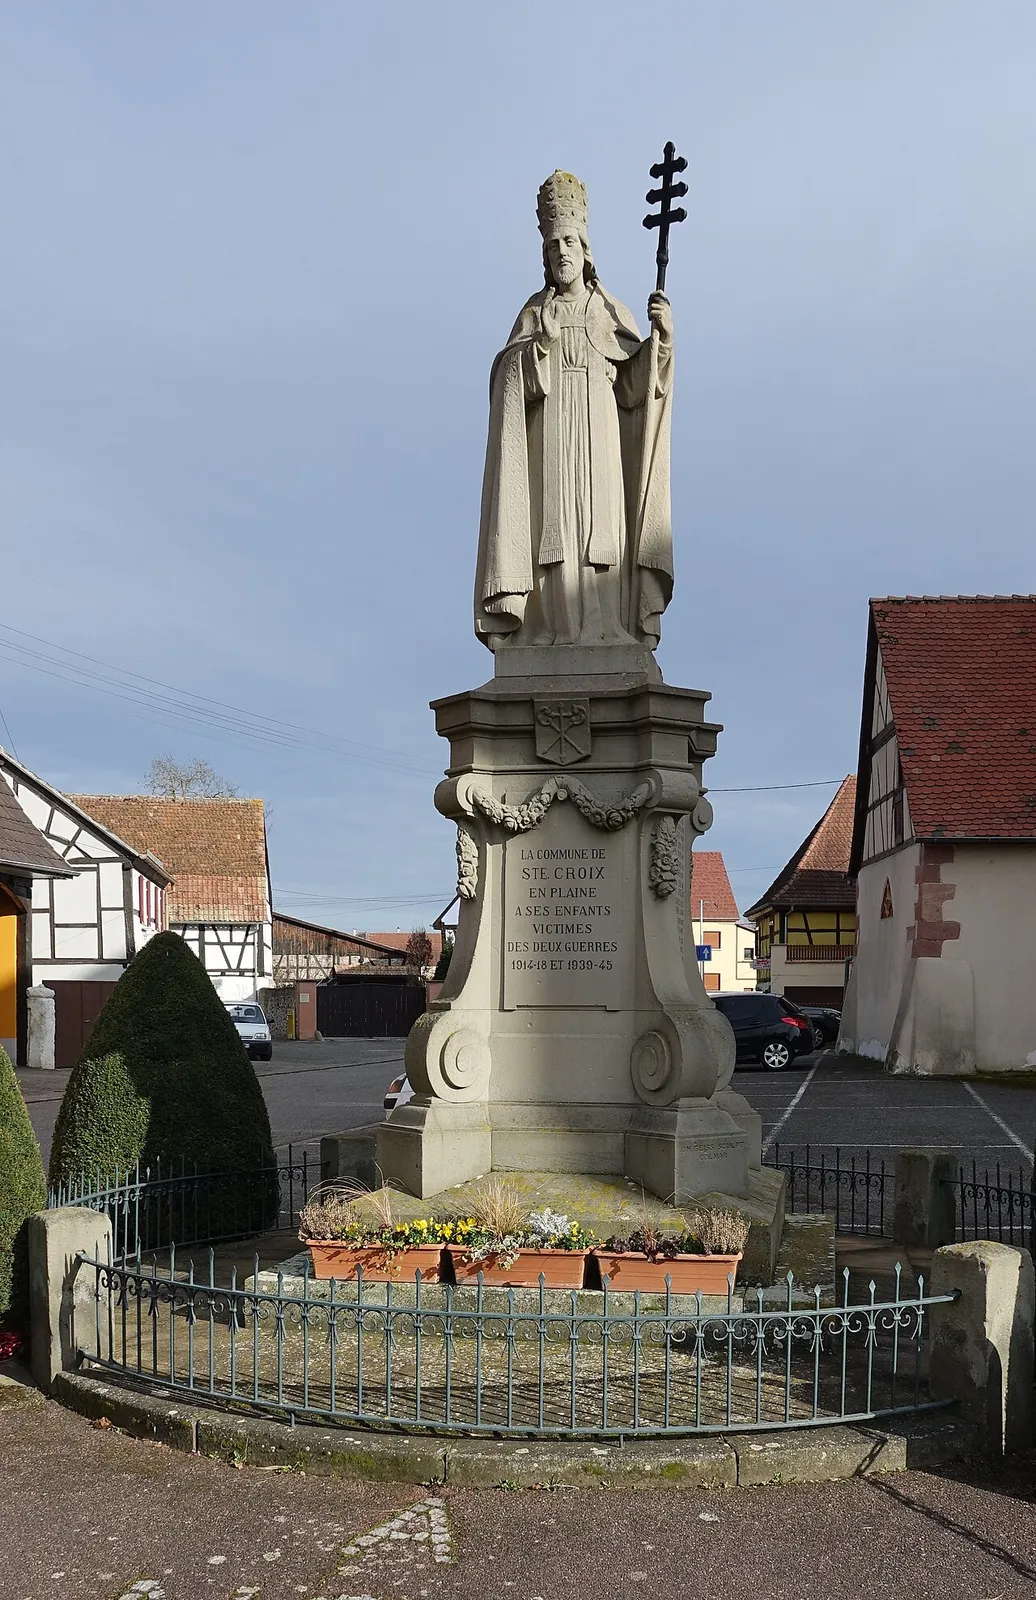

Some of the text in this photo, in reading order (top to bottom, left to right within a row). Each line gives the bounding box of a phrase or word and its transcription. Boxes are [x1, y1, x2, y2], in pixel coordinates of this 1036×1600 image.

[521, 849, 606, 860] LA COMMUNE DE
[522, 867, 605, 880] STE. CROIX
[529, 888, 596, 898] EN PLAINE
[515, 906, 611, 916] A SES ENFANTS
[532, 924, 592, 934] VICTIMES
[508, 942, 618, 952] DES DEUX GUERRES
[512, 960, 613, 970] 1914-18 ET 1939-45
